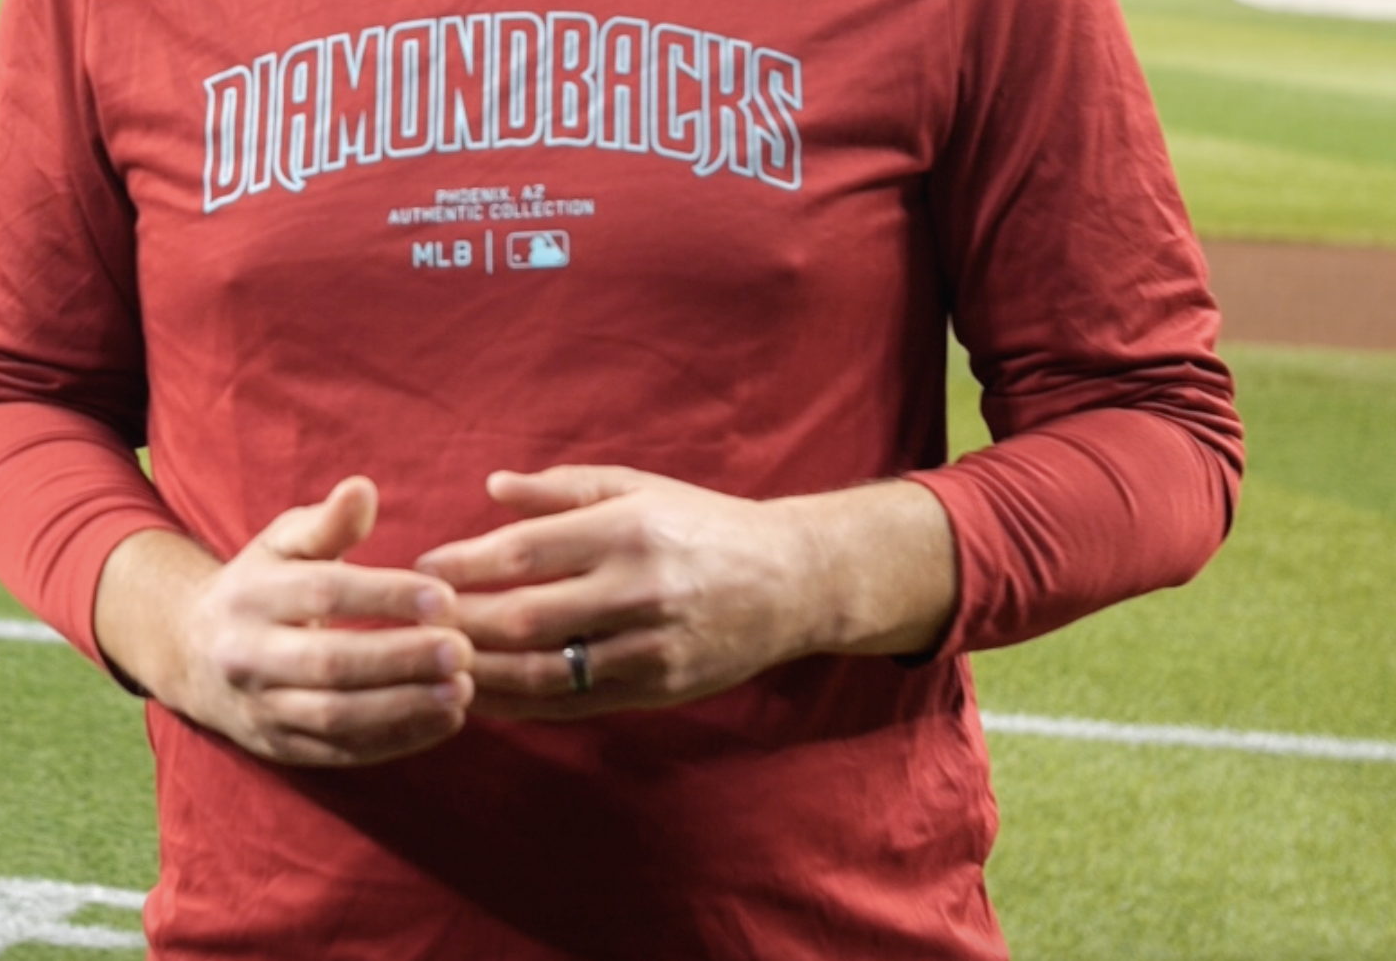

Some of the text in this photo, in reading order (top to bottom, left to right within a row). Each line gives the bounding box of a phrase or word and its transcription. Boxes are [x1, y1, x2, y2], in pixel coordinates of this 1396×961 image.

[203, 11, 803, 213] DIAMONDBACKS
[435, 183, 546, 205] PHOENIX, AZ
[388, 198, 595, 225] AUTHENTIC COLLECTION
[412, 239, 472, 268] MLB
